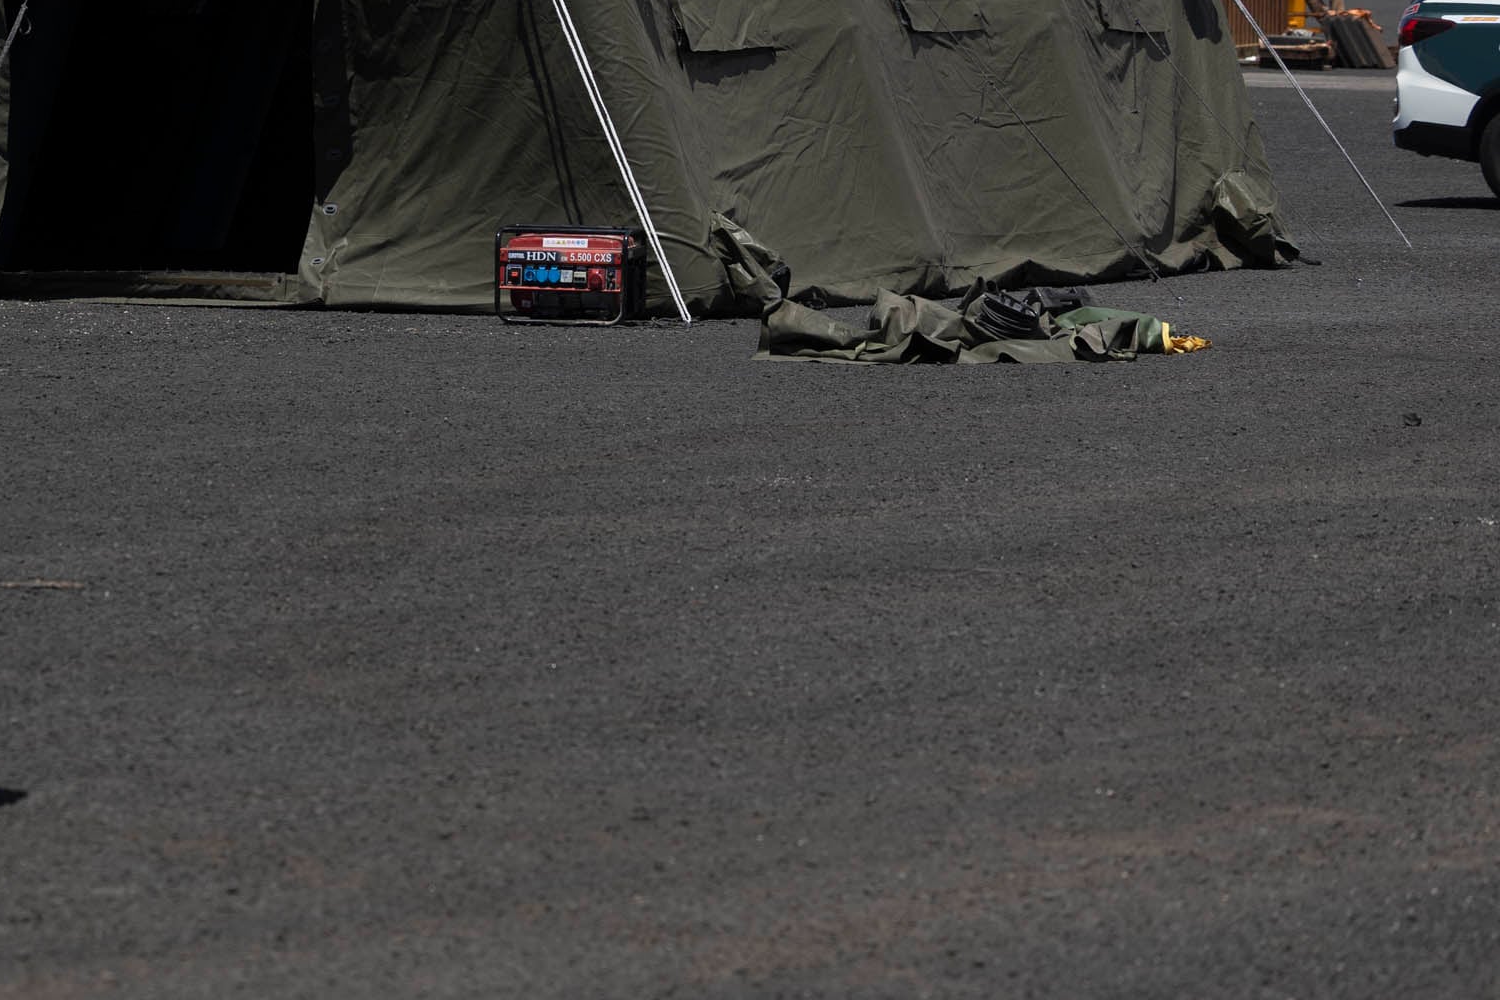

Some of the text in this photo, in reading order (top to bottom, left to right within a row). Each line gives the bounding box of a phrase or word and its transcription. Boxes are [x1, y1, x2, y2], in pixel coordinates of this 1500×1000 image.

[526, 251, 557, 261] HDN
[570, 252, 592, 262] 5.500
[593, 253, 612, 263] CXS
